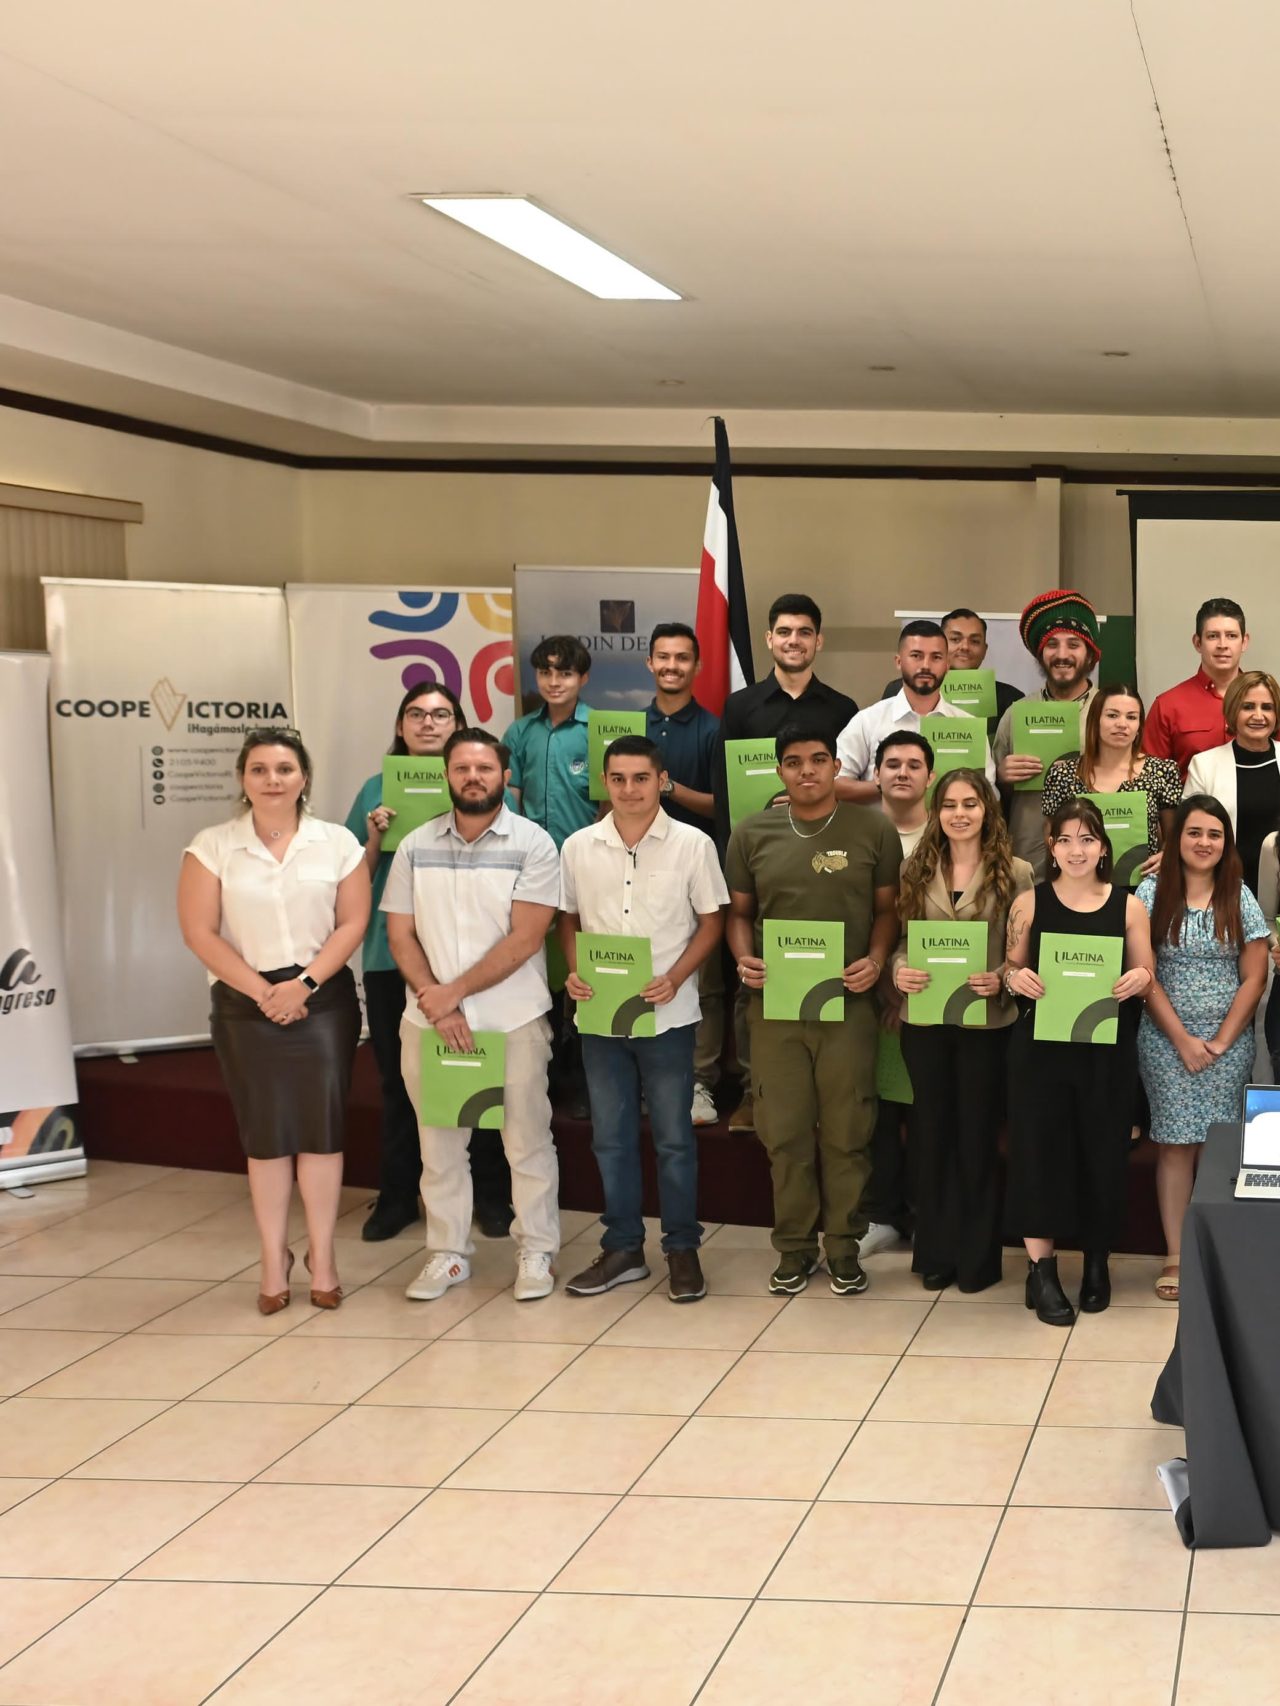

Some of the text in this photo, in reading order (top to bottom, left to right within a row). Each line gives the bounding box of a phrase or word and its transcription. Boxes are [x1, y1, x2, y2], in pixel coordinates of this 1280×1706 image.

[621, 635, 649, 652] DE
[1025, 716, 1066, 726] ULATINA
[932, 731, 973, 742] ULATINA
[1103, 807, 1133, 816] ATINA
[777, 936, 827, 948] ULATINA
[922, 938, 970, 950] ULATINA
[590, 949, 635, 962] ULATINA
[1055, 951, 1105, 964] ULATINA
